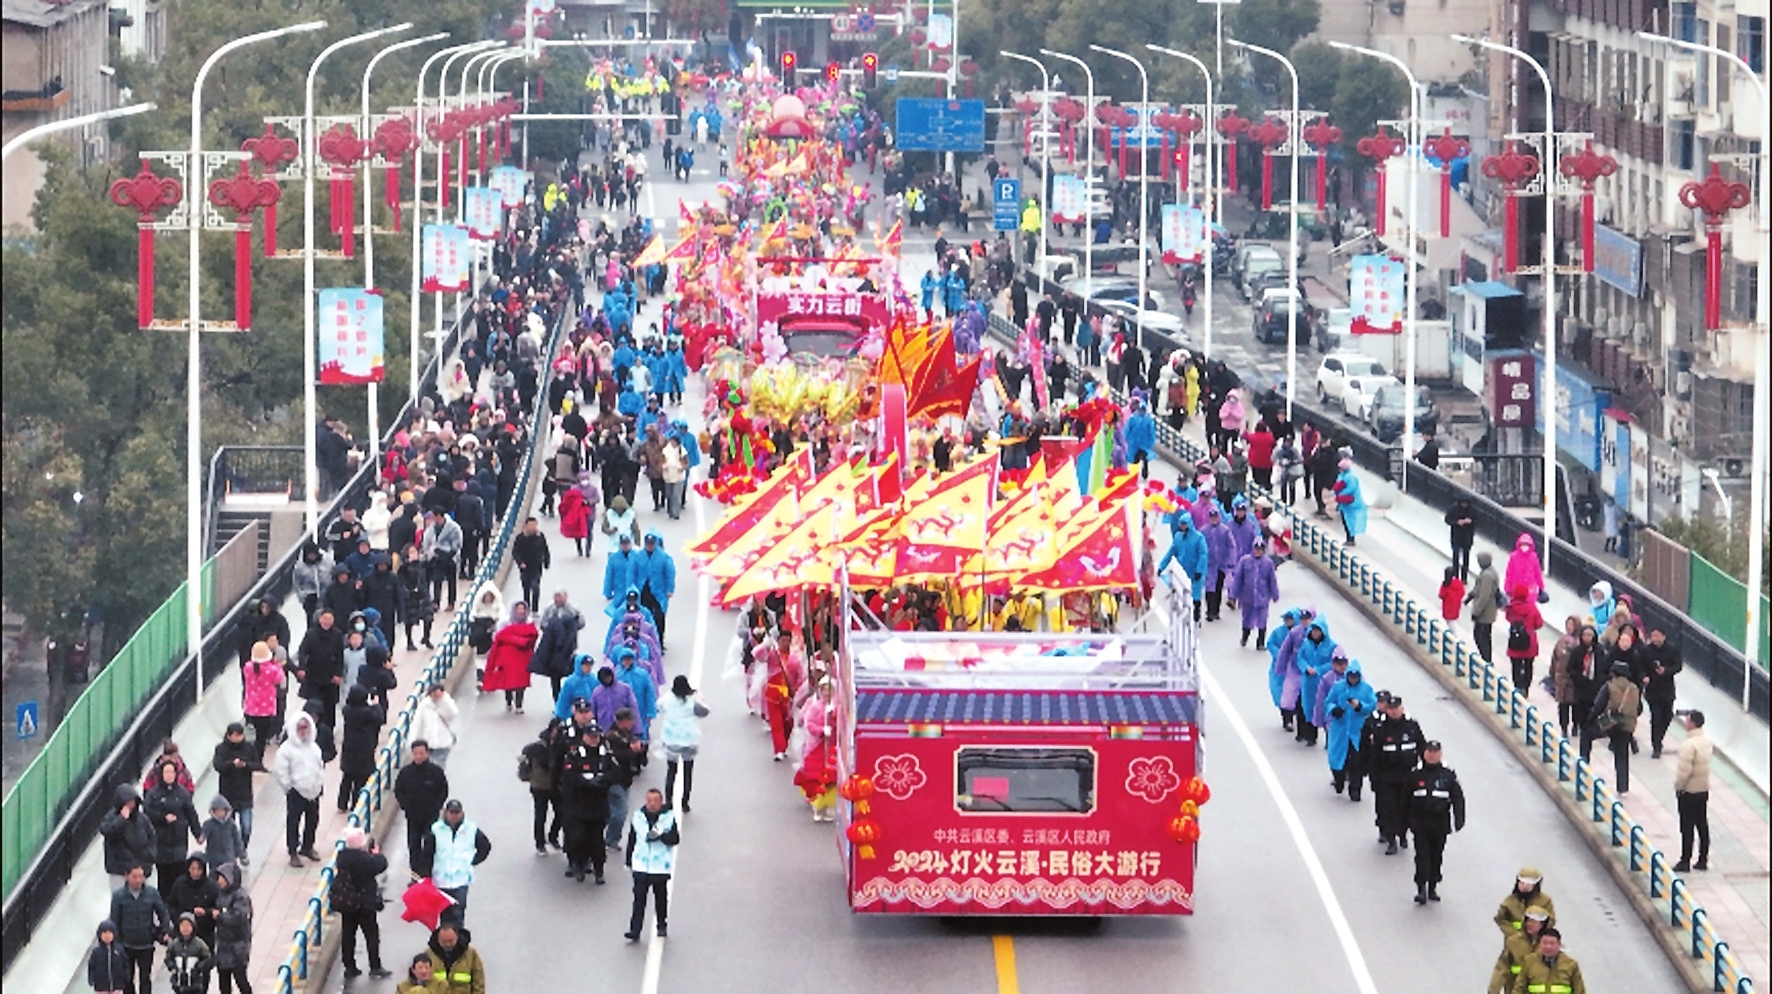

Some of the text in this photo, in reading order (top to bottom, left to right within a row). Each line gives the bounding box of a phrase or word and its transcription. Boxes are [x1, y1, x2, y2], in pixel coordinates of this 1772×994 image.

[787, 293, 862, 315] 实力云街
[888, 849, 1162, 877] 2024灯火云溪·民俗大游行
